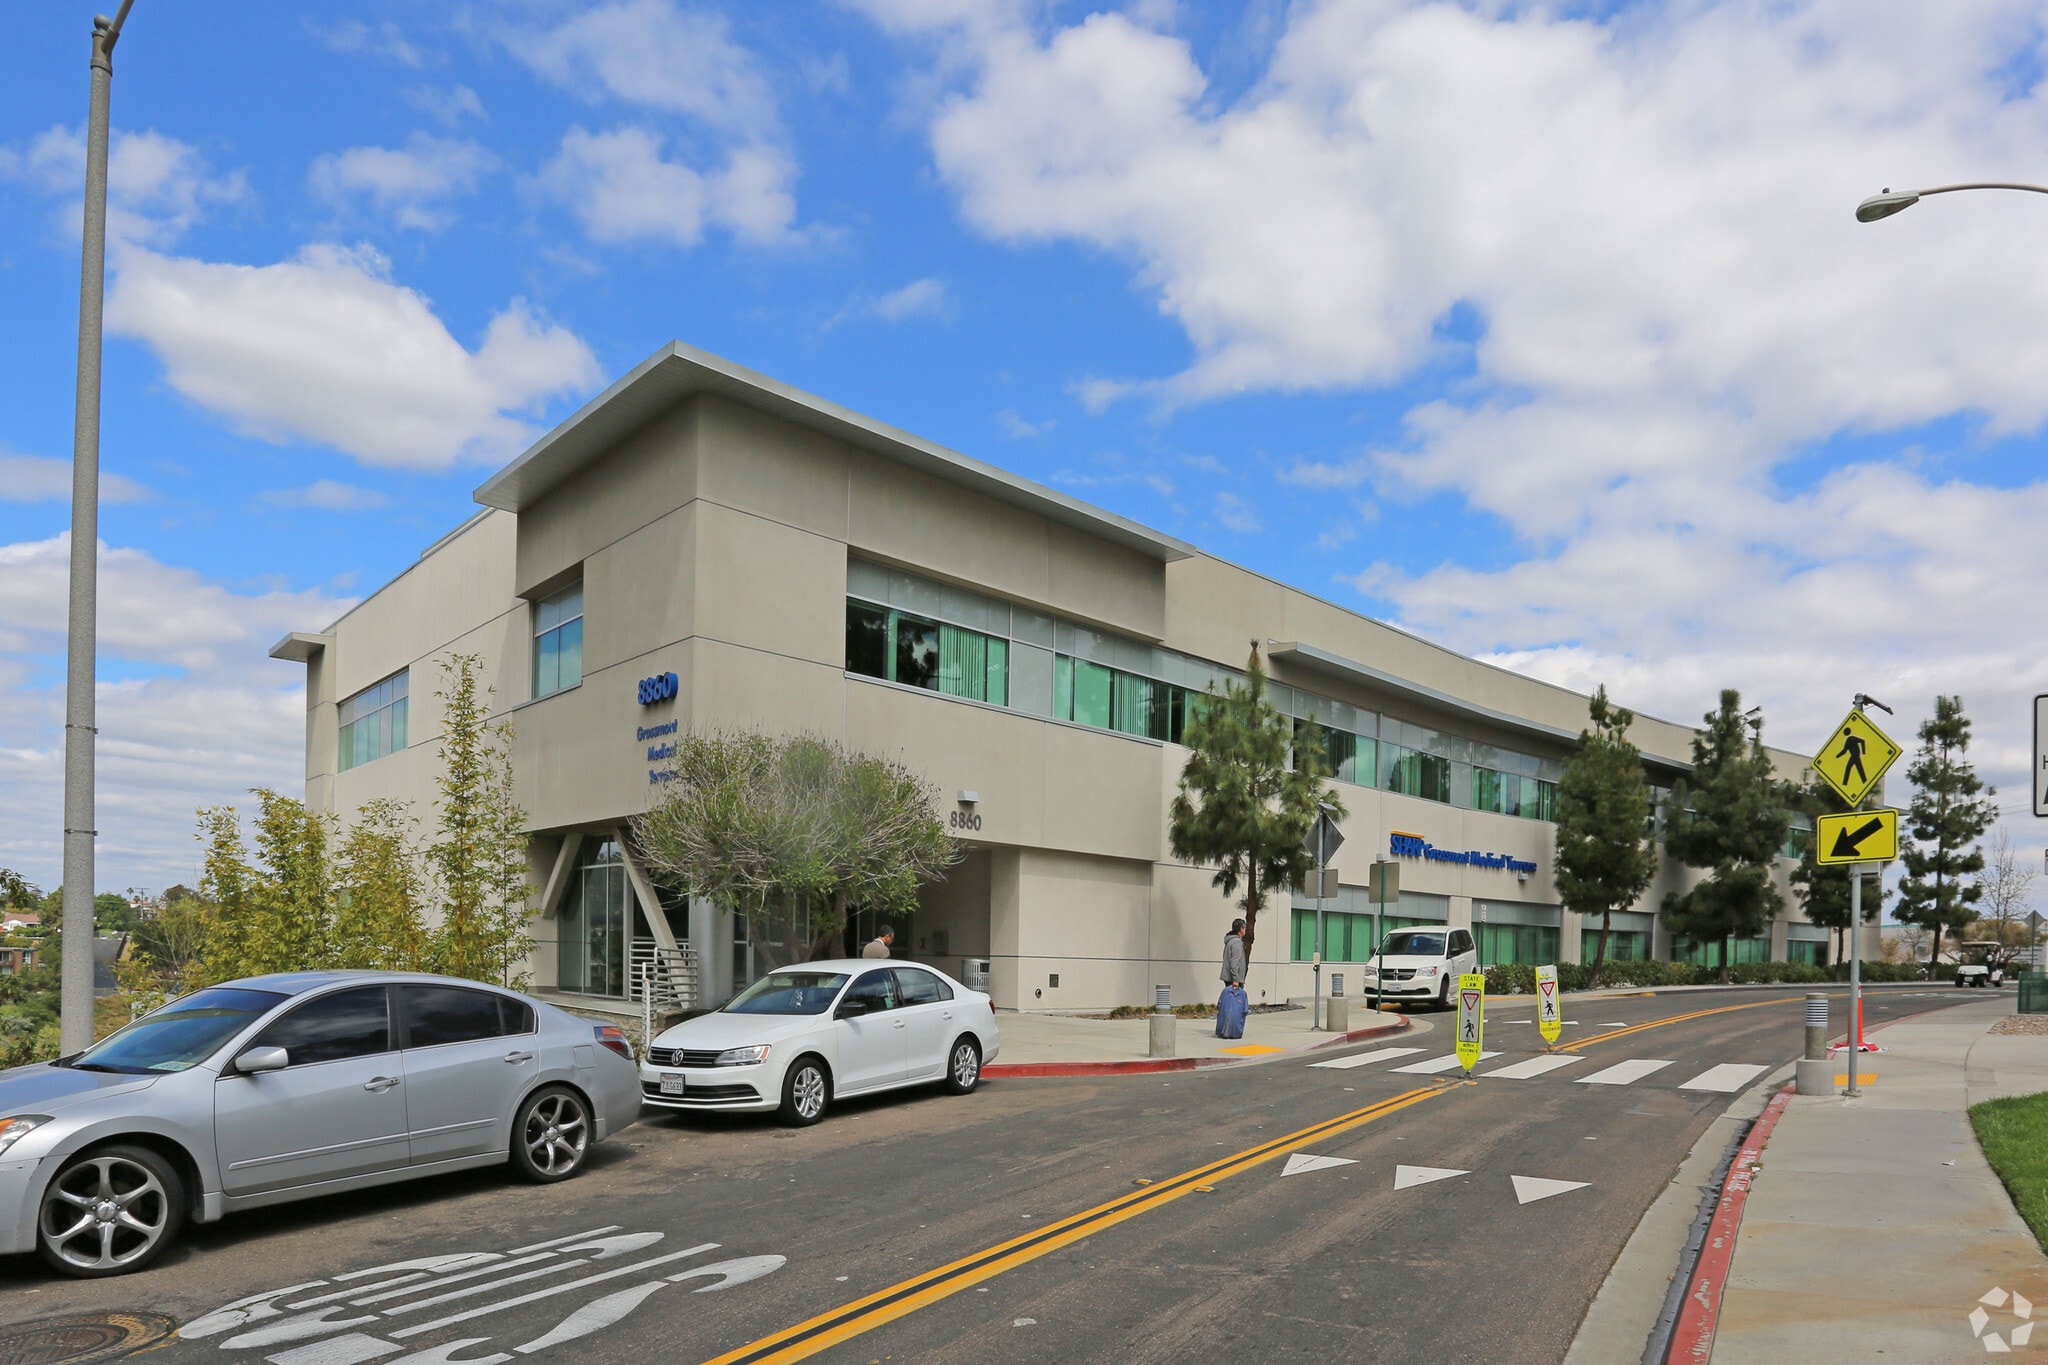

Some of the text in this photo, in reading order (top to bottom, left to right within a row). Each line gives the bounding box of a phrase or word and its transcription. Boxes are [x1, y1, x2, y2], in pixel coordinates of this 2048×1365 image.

[637, 671, 679, 705] 8860
[637, 719, 678, 742] Grossmont
[950, 810, 982, 831] 8860
[1390, 833, 1425, 857] SHARP
[1470, 850, 1506, 868] Medical
